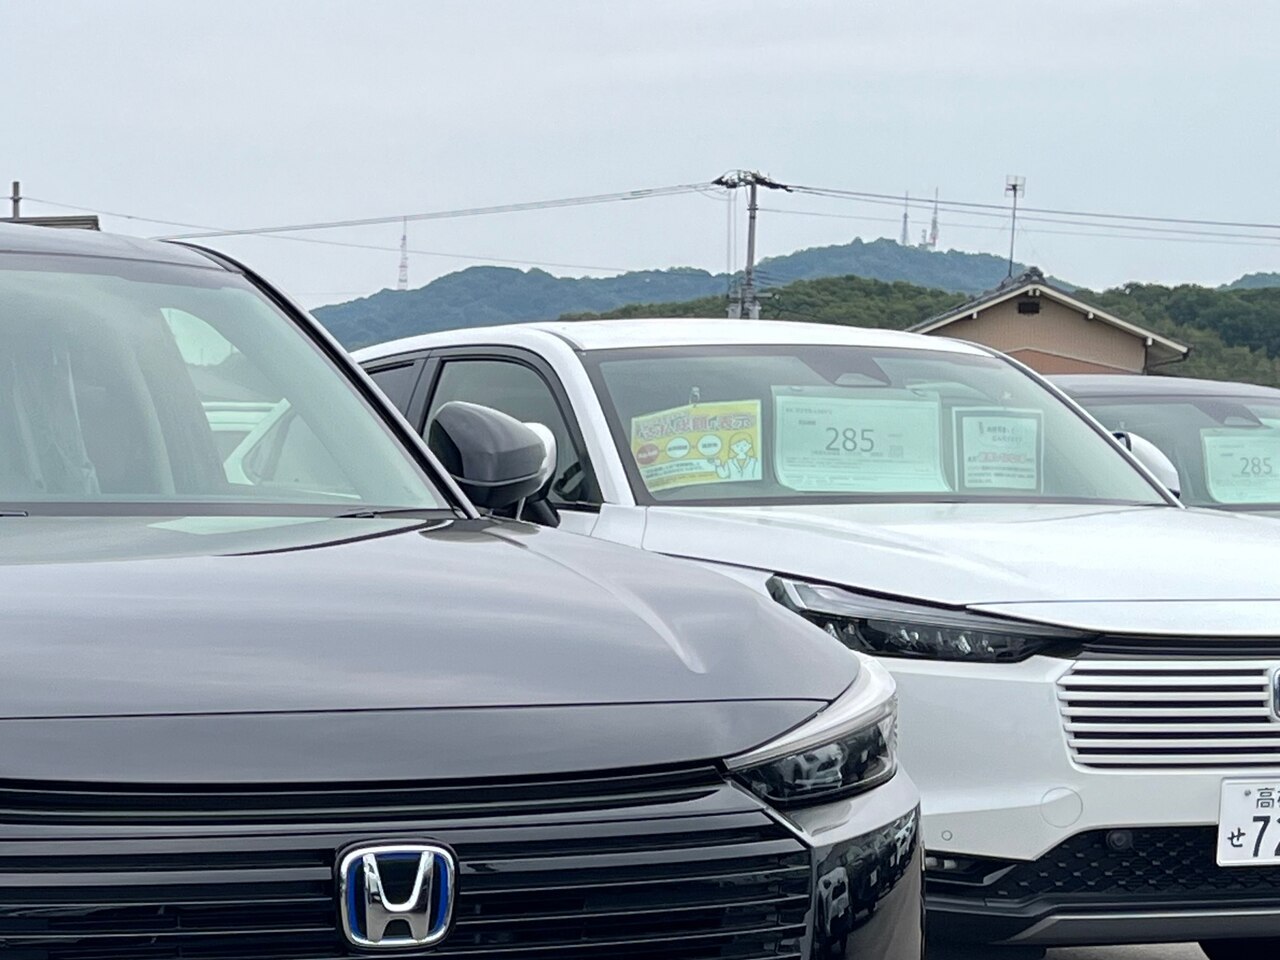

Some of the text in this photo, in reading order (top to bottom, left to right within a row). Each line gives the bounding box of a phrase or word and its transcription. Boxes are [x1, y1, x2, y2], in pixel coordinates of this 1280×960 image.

[824, 426, 875, 453] 285
[1239, 456, 1273, 475] 285
[1256, 787, 1280, 809] 高
